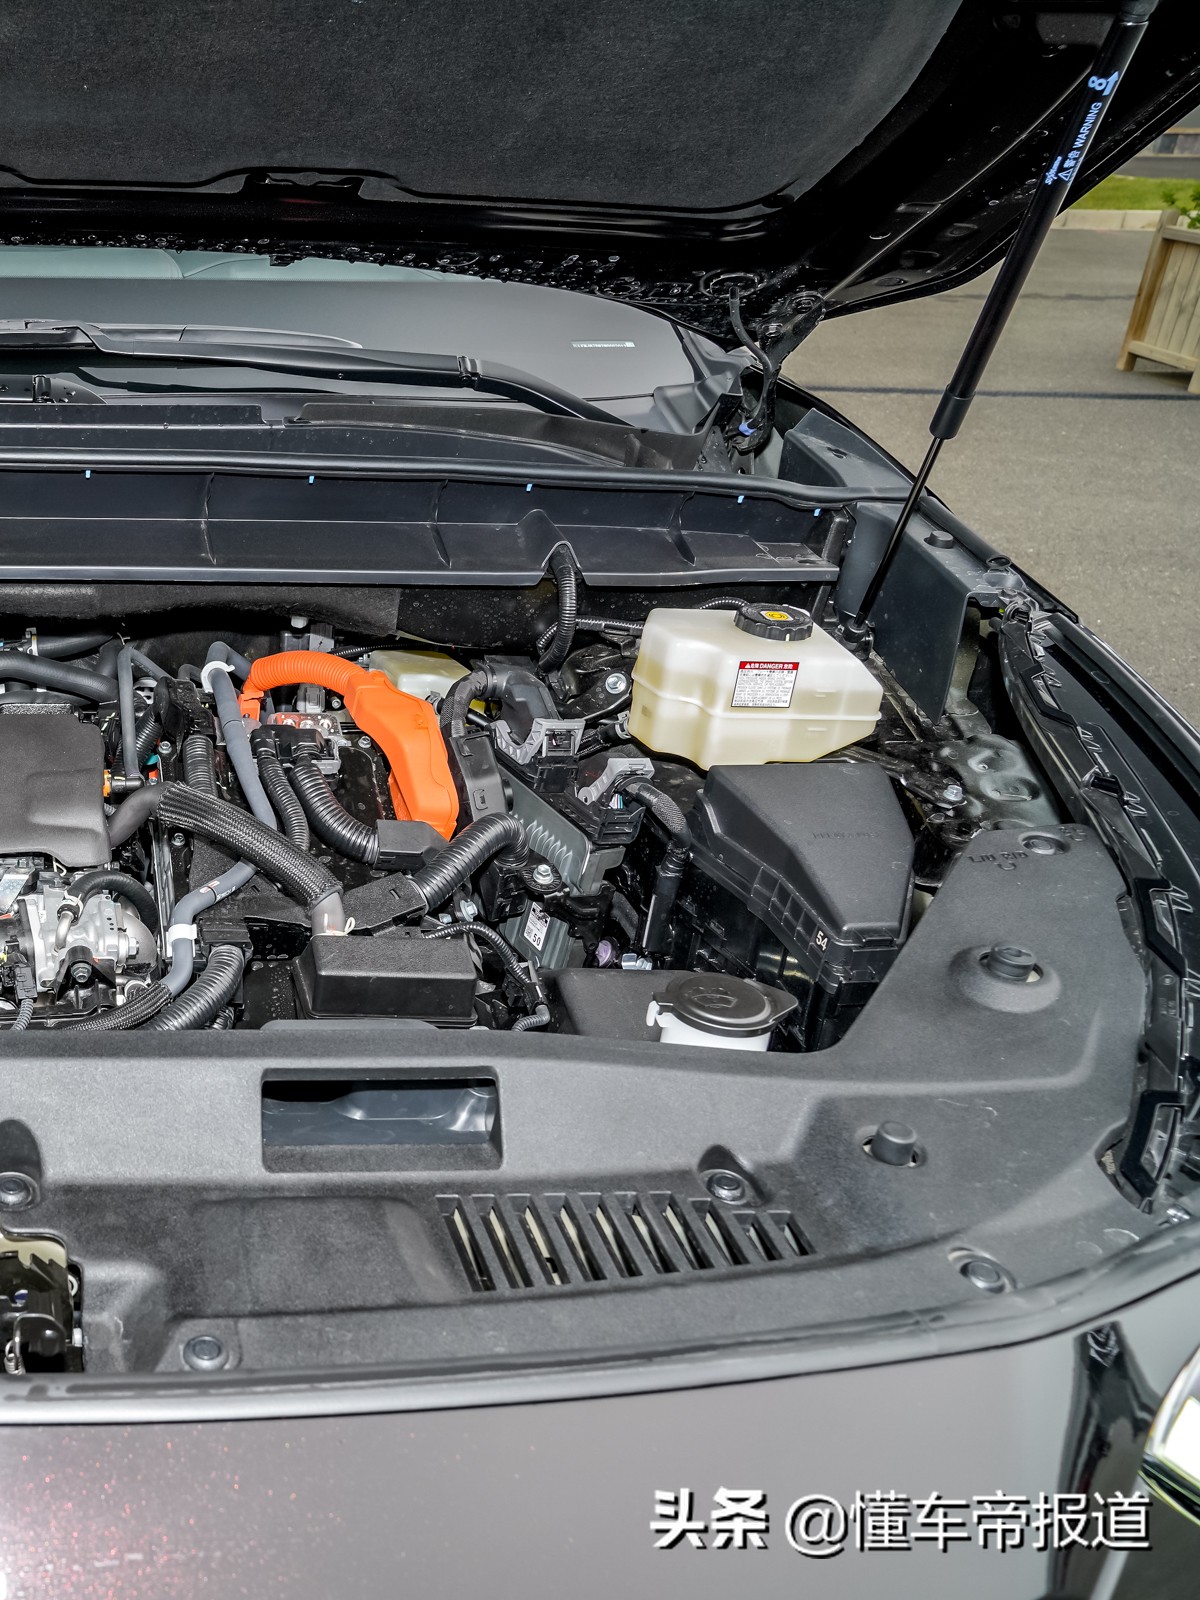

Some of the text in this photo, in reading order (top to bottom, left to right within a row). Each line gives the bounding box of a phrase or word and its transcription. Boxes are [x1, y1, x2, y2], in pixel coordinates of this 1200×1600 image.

[1088, 75, 1107, 91] 8
[1072, 102, 1103, 149] WARNING
[816, 930, 828, 950] 54
